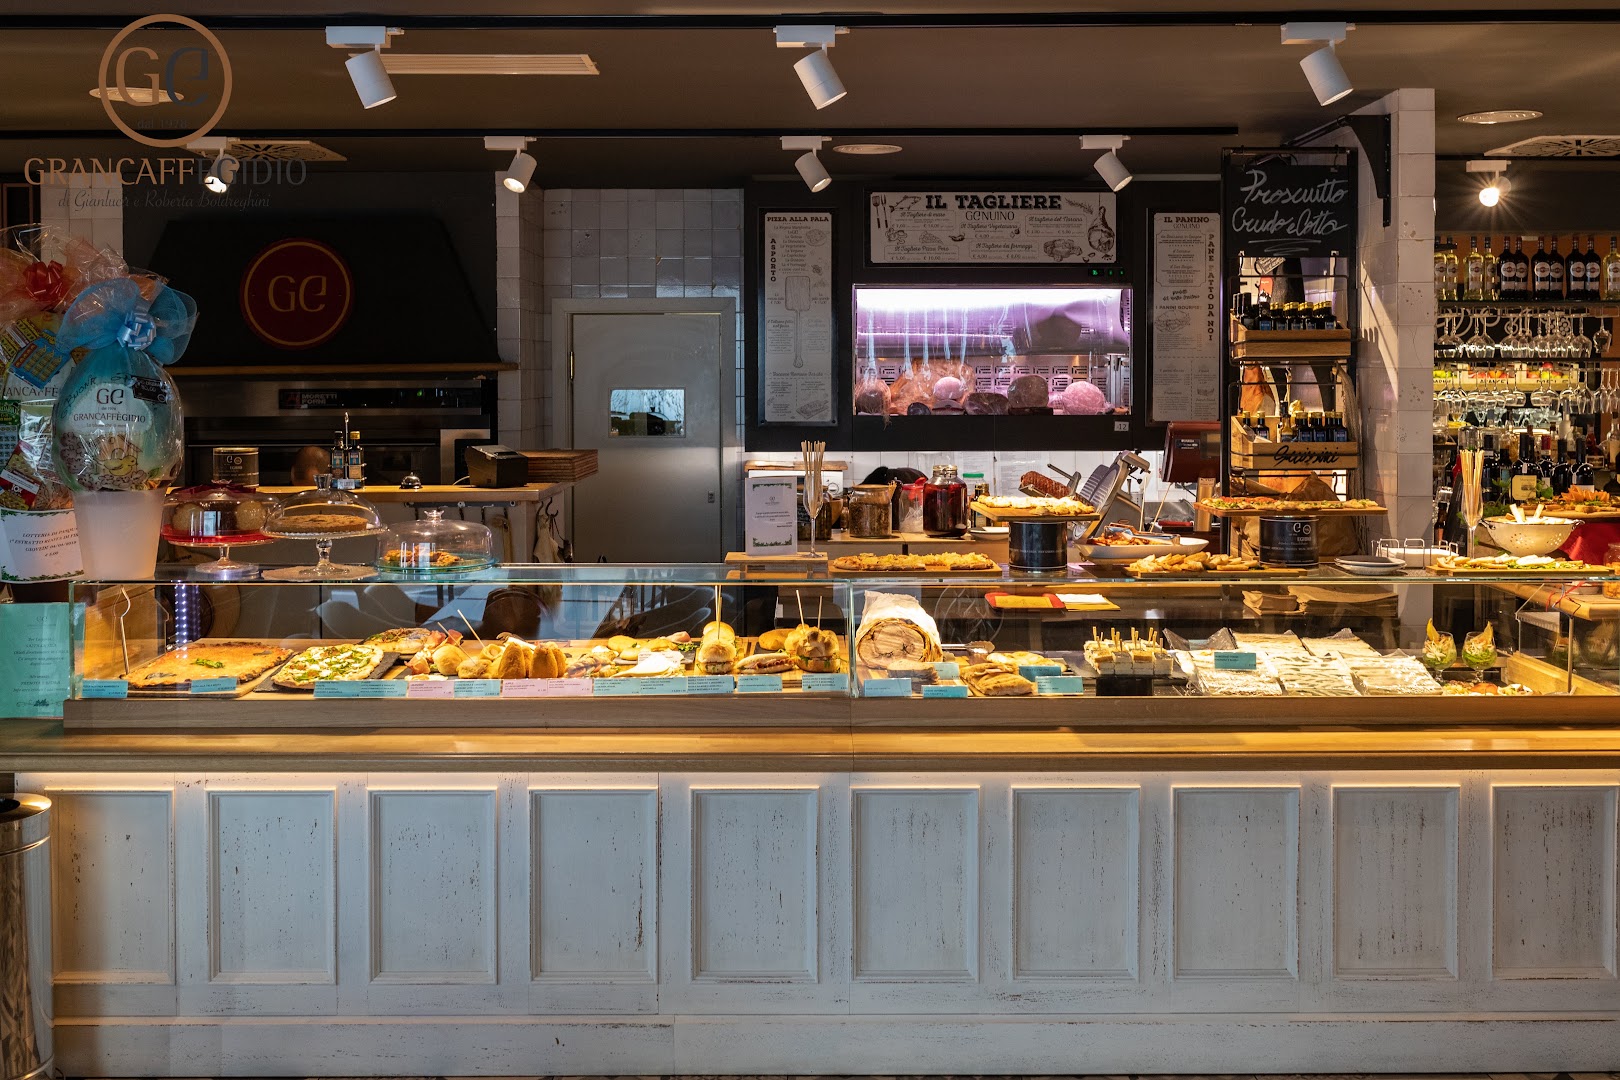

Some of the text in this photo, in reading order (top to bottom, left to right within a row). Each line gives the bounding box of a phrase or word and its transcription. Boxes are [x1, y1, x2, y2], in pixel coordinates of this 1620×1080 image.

[925, 194, 1062, 211] IL TAGLIERE
[1231, 206, 1294, 235] Crudo
[1295, 208, 1348, 237] Cotto
[1207, 234, 1215, 262] PANE
[1207, 303, 1215, 317] DA
[1207, 320, 1215, 341] NOI
